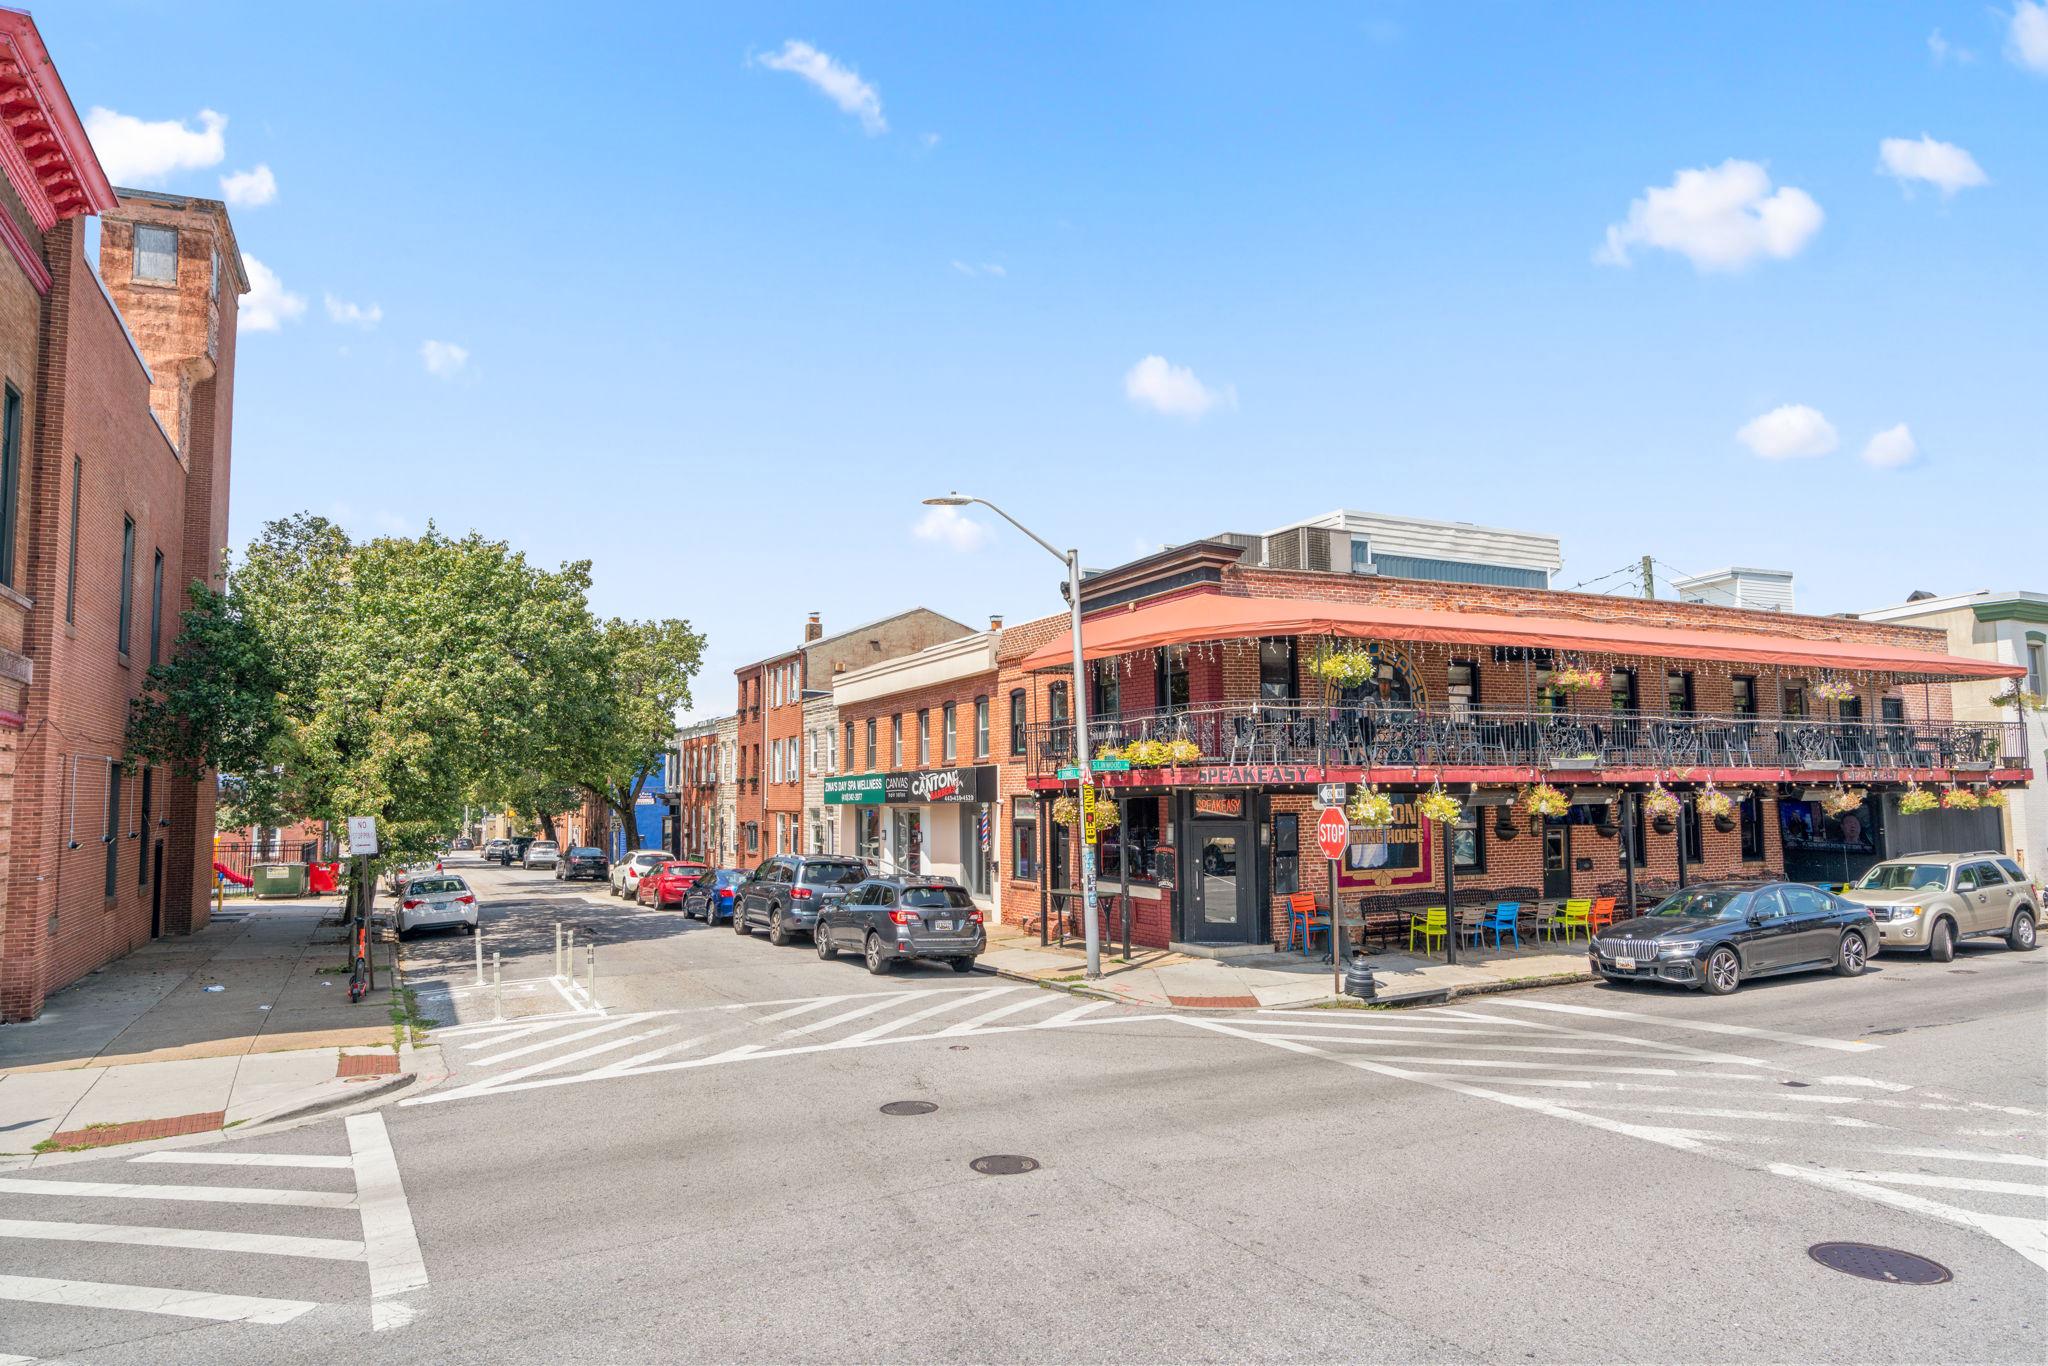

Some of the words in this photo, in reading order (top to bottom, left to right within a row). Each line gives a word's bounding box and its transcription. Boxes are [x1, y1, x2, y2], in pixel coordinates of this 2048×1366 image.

[1199, 767, 1309, 783] SPEAKEASY
[838, 781, 847, 791] DAY
[847, 780, 857, 791] SPA
[857, 778, 882, 790] WELLNESS
[885, 777, 909, 790] CANVAS
[911, 771, 956, 797] CANTON
[1084, 788, 1095, 812] KIND
[1196, 798, 1241, 813] SPEAKEASY
[357, 821, 367, 829] NO
[611, 822, 622, 831] 25
[1320, 823, 1345, 843] STOP
[1350, 829, 1383, 844] INING
[1387, 828, 1424, 844] HOUSE
